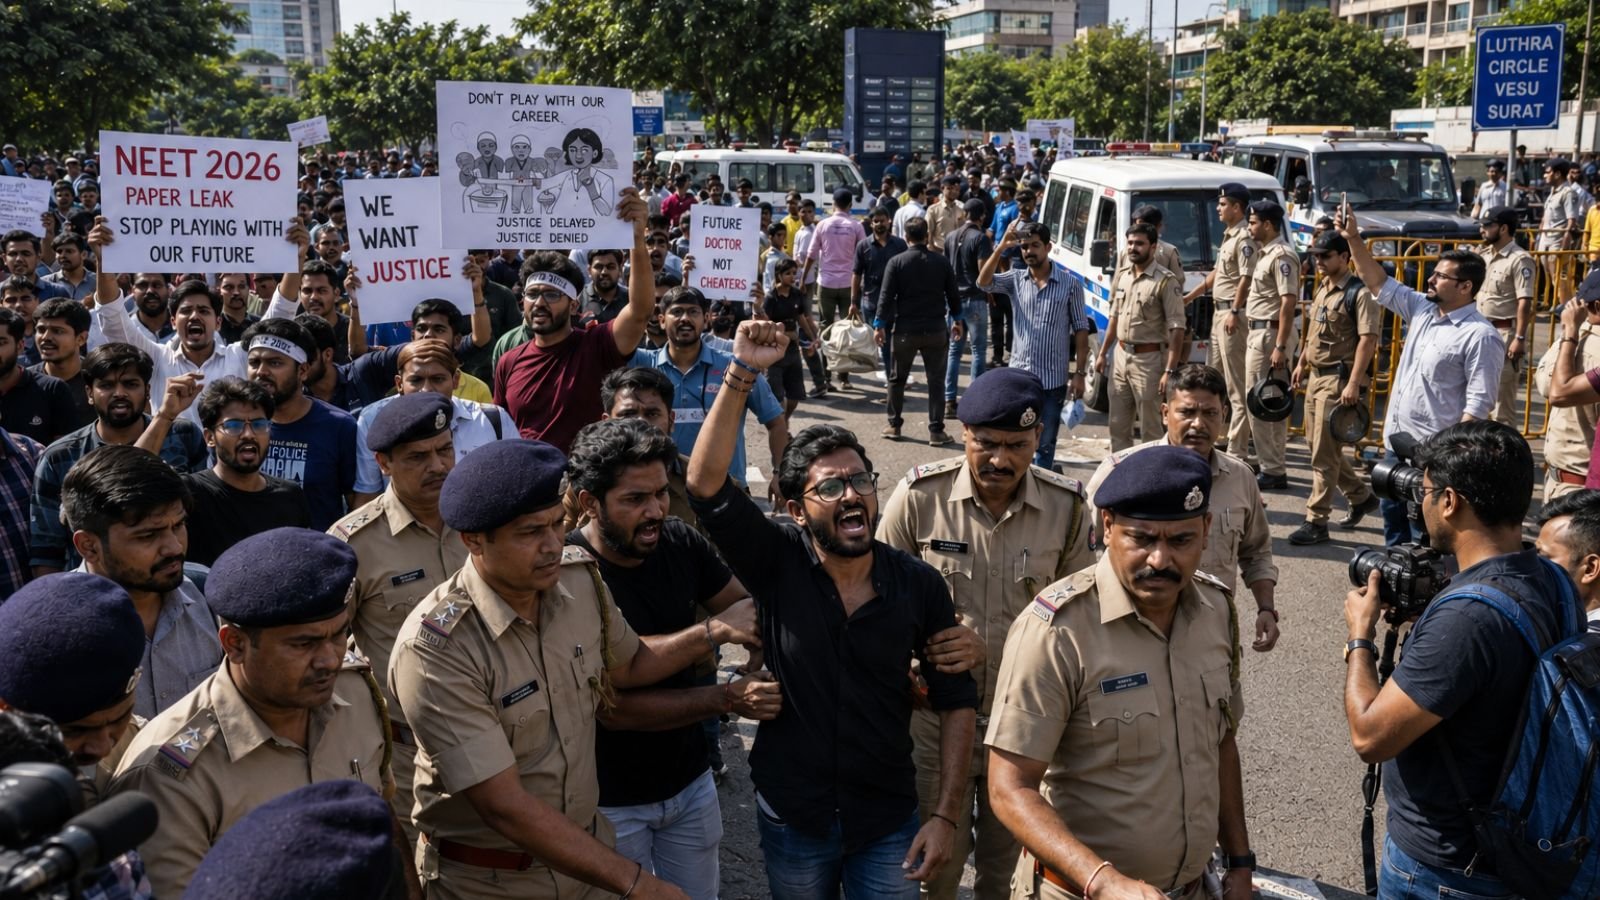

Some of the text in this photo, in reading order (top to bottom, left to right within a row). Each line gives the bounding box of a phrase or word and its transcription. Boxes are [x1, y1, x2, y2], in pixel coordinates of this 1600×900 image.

[1486, 35, 1553, 53] LUTHRA
[1489, 58, 1548, 74] CIRCLE
[1495, 81, 1539, 96] VESU
[469, 90, 604, 107] DON'T PLAY WITH OUR
[1488, 103, 1544, 119] SURAT
[116, 145, 280, 181] NEET 2026
[126, 187, 234, 208] PAPER LEAK
[360, 196, 394, 217] WE
[120, 217, 282, 236] STOP PLAYING WITH
[497, 217, 595, 228] JUSTICE DELAYED
[703, 216, 742, 230] FUTURE
[359, 226, 419, 249] WANT
[496, 232, 588, 243] JUSTICE DENIED
[705, 237, 742, 250] DOCTOR
[150, 246, 254, 263] OUR FUTURE
[367, 257, 451, 283] JUSTICE
[713, 258, 733, 270] NOT
[700, 277, 747, 290] CHEATERS
